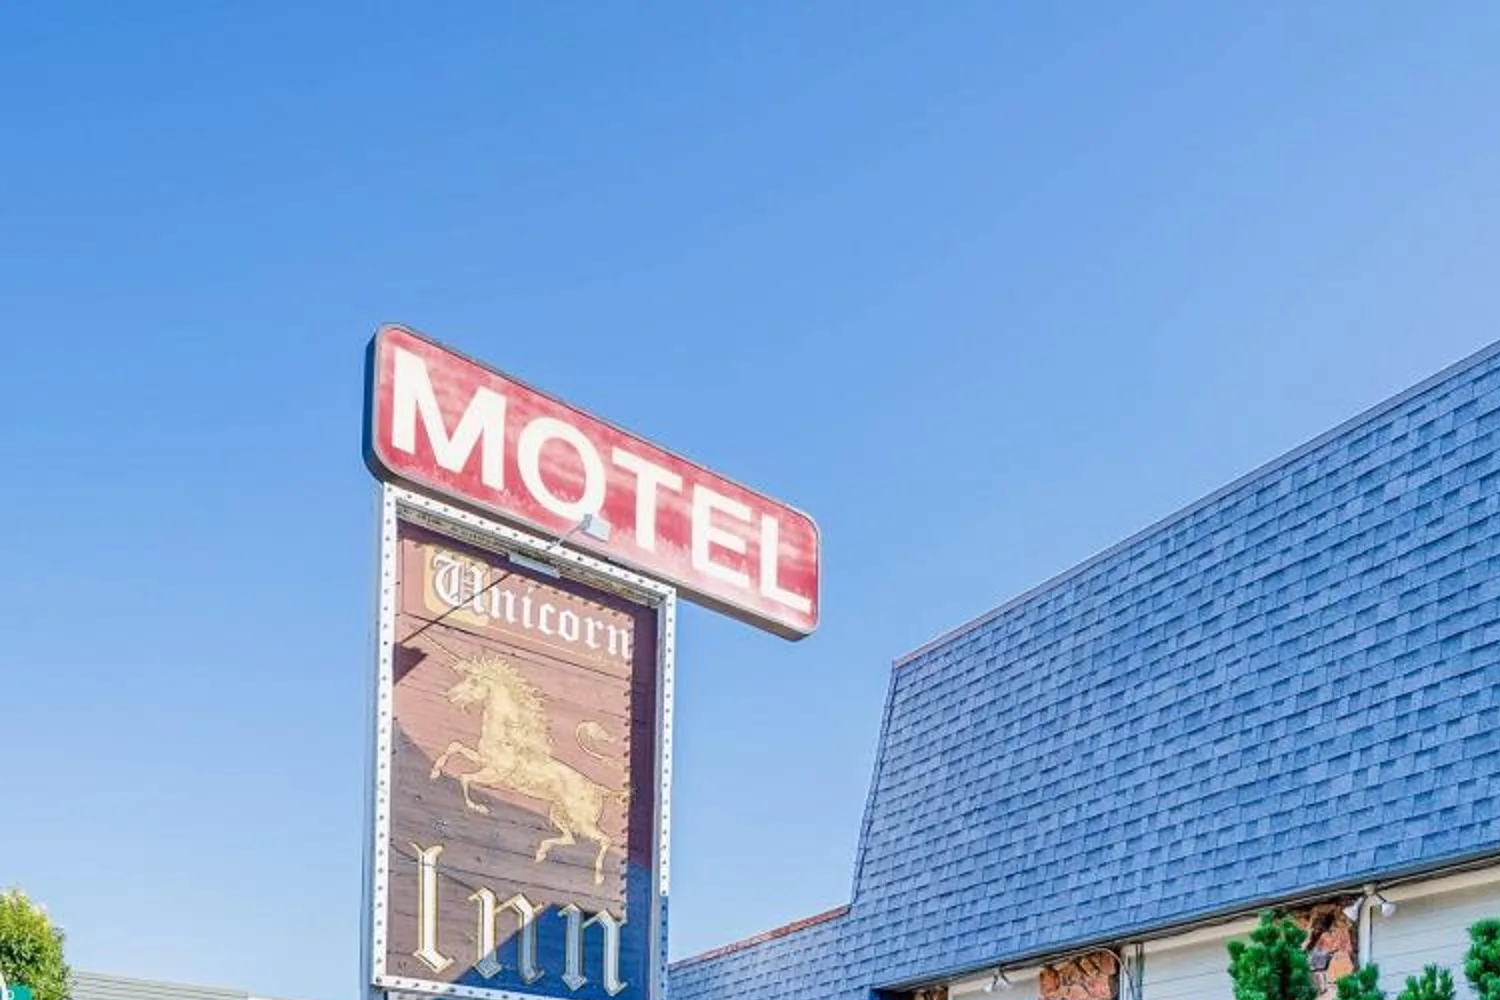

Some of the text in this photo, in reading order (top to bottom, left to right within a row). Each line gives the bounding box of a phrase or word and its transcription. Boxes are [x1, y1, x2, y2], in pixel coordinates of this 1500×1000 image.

[390, 347, 812, 613] MOTEL
[431, 552, 631, 660] Unicorn
[409, 842, 628, 997] Inn
